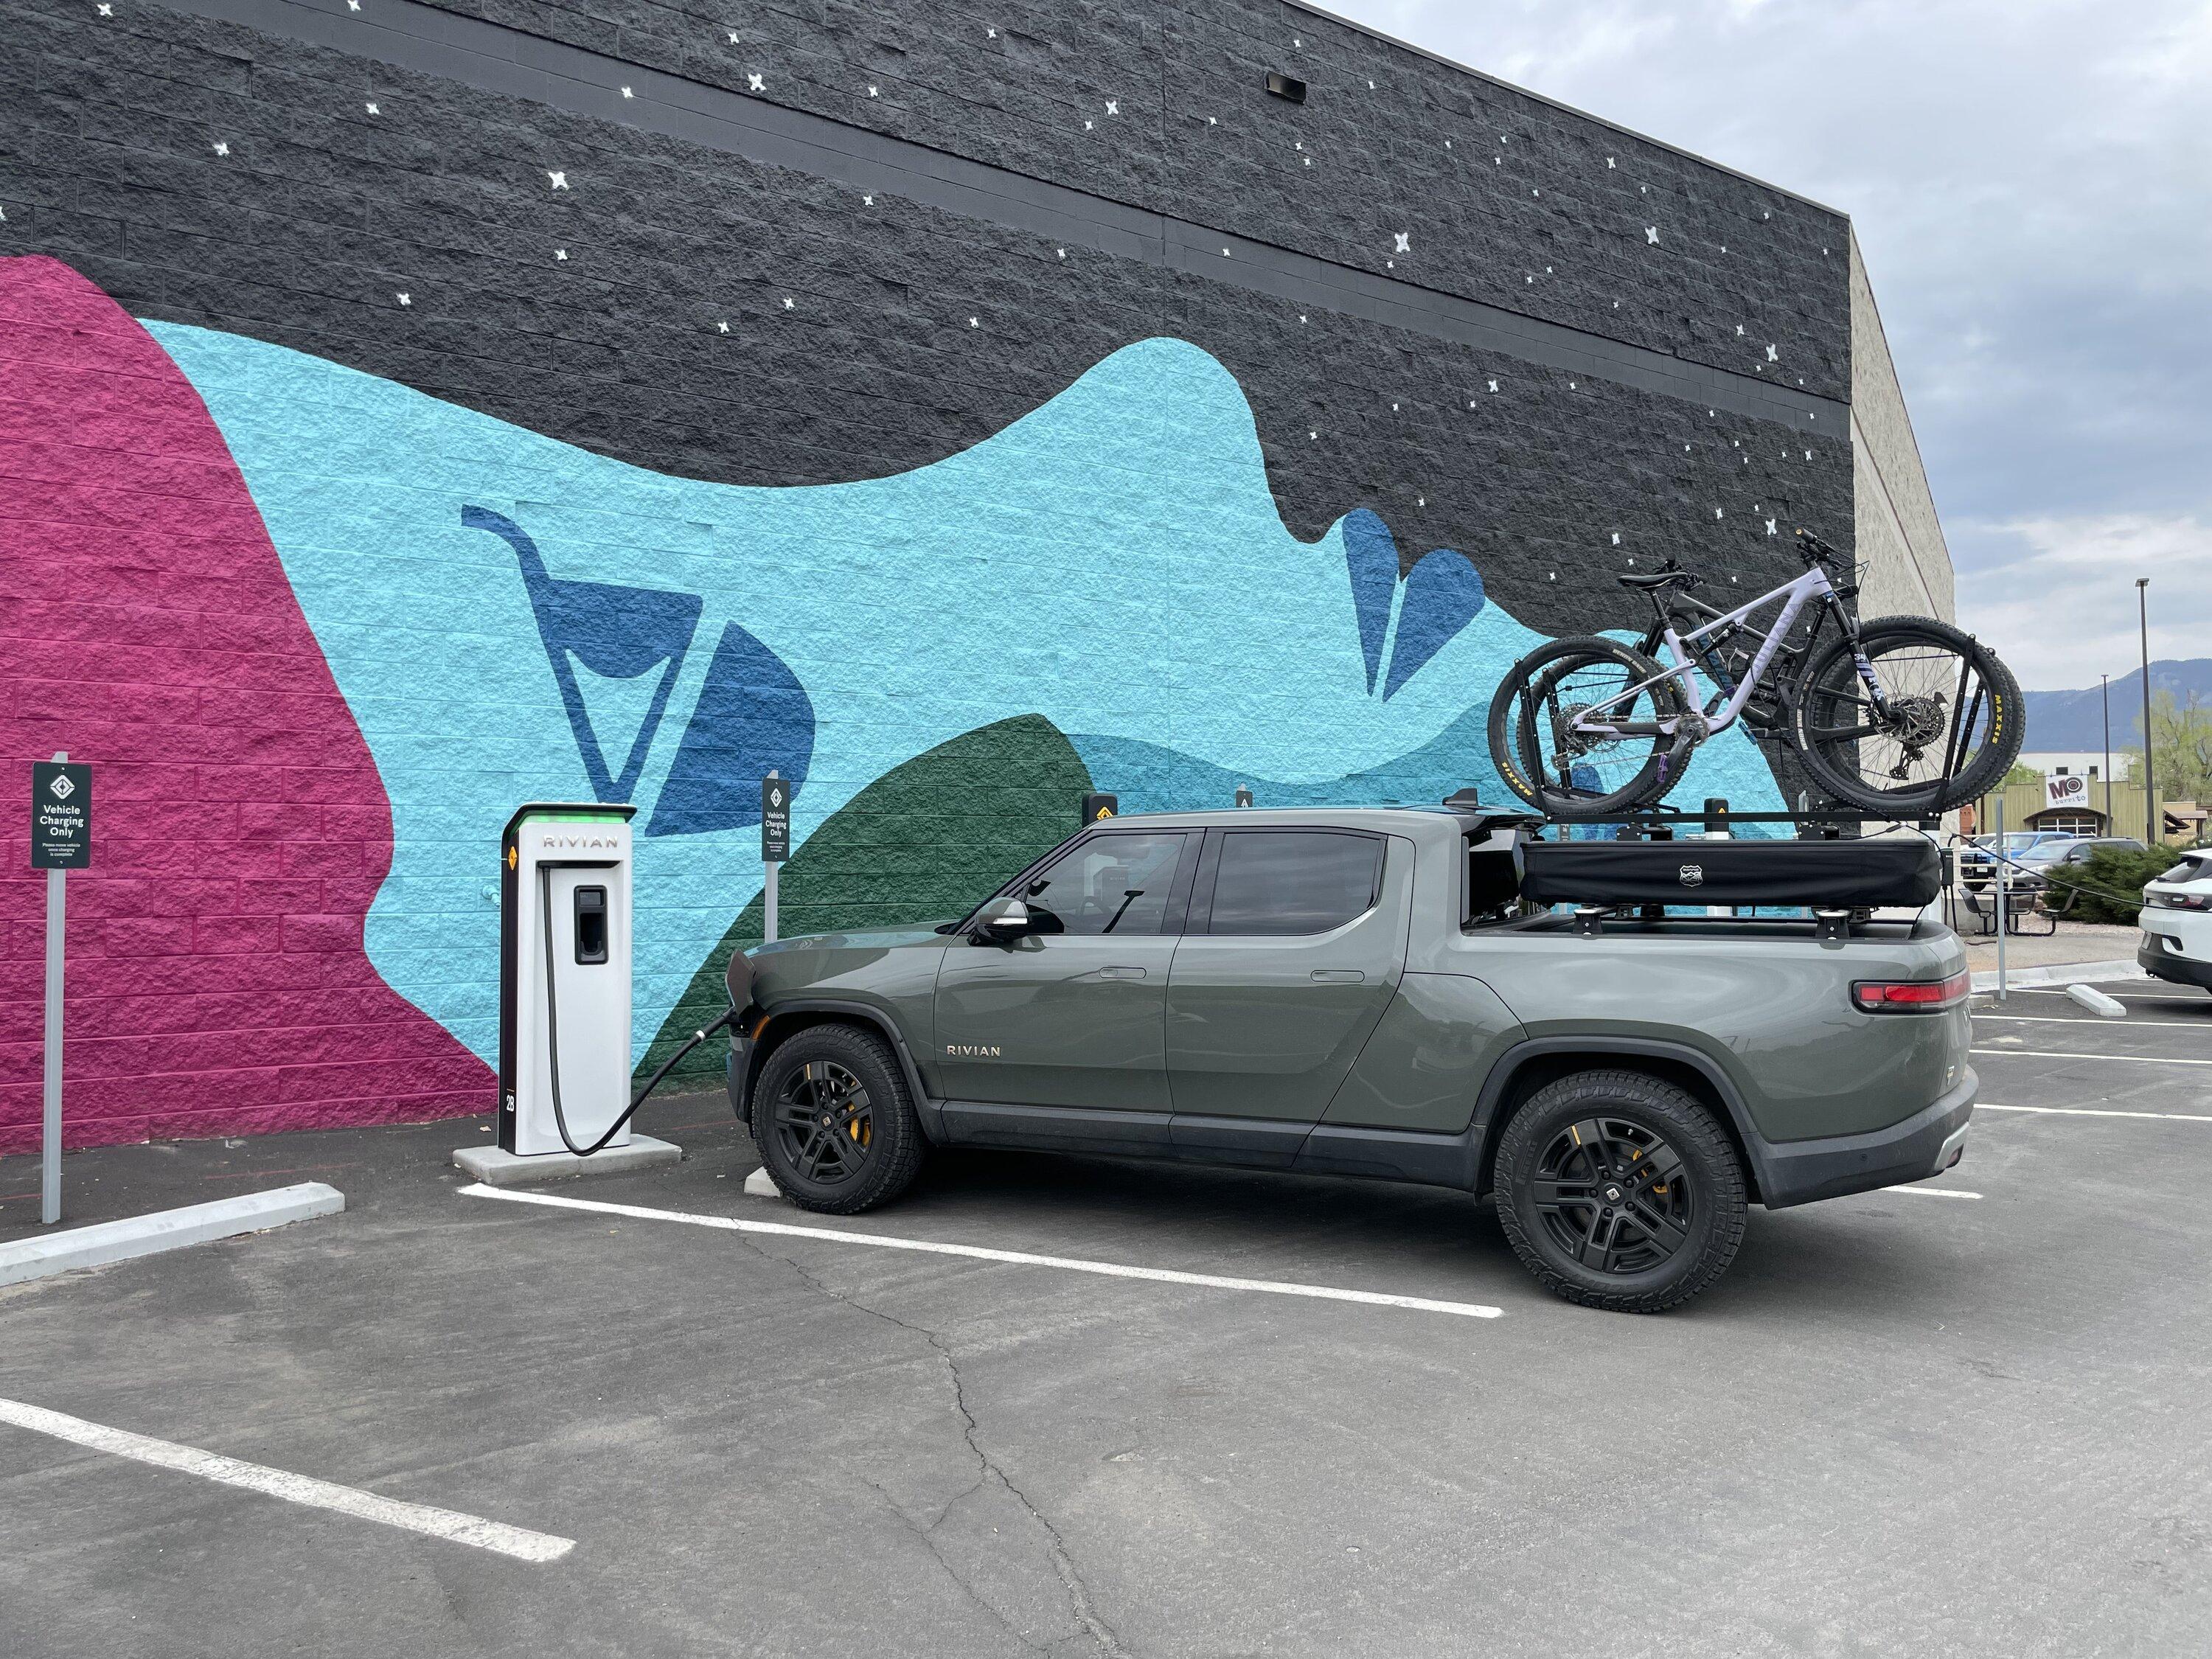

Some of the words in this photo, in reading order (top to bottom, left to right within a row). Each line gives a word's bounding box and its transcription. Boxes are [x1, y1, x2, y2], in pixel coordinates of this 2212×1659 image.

[1751, 603, 1801, 674] JULIANA
[1992, 694, 2003, 744] MAXXIS
[1501, 762, 1533, 796] MAXXIS
[2055, 795, 2086, 804] burrito
[44, 804, 80, 815] Vehicle
[767, 811, 785, 819] Vehicle
[40, 815, 84, 828] Charging
[765, 820, 787, 830] Charging
[49, 827, 74, 838] Only
[770, 829, 782, 838] Only
[543, 834, 619, 848] RIVIAN
[946, 1045, 1001, 1057] RIVIAN
[506, 1094, 515, 1112] 2B
